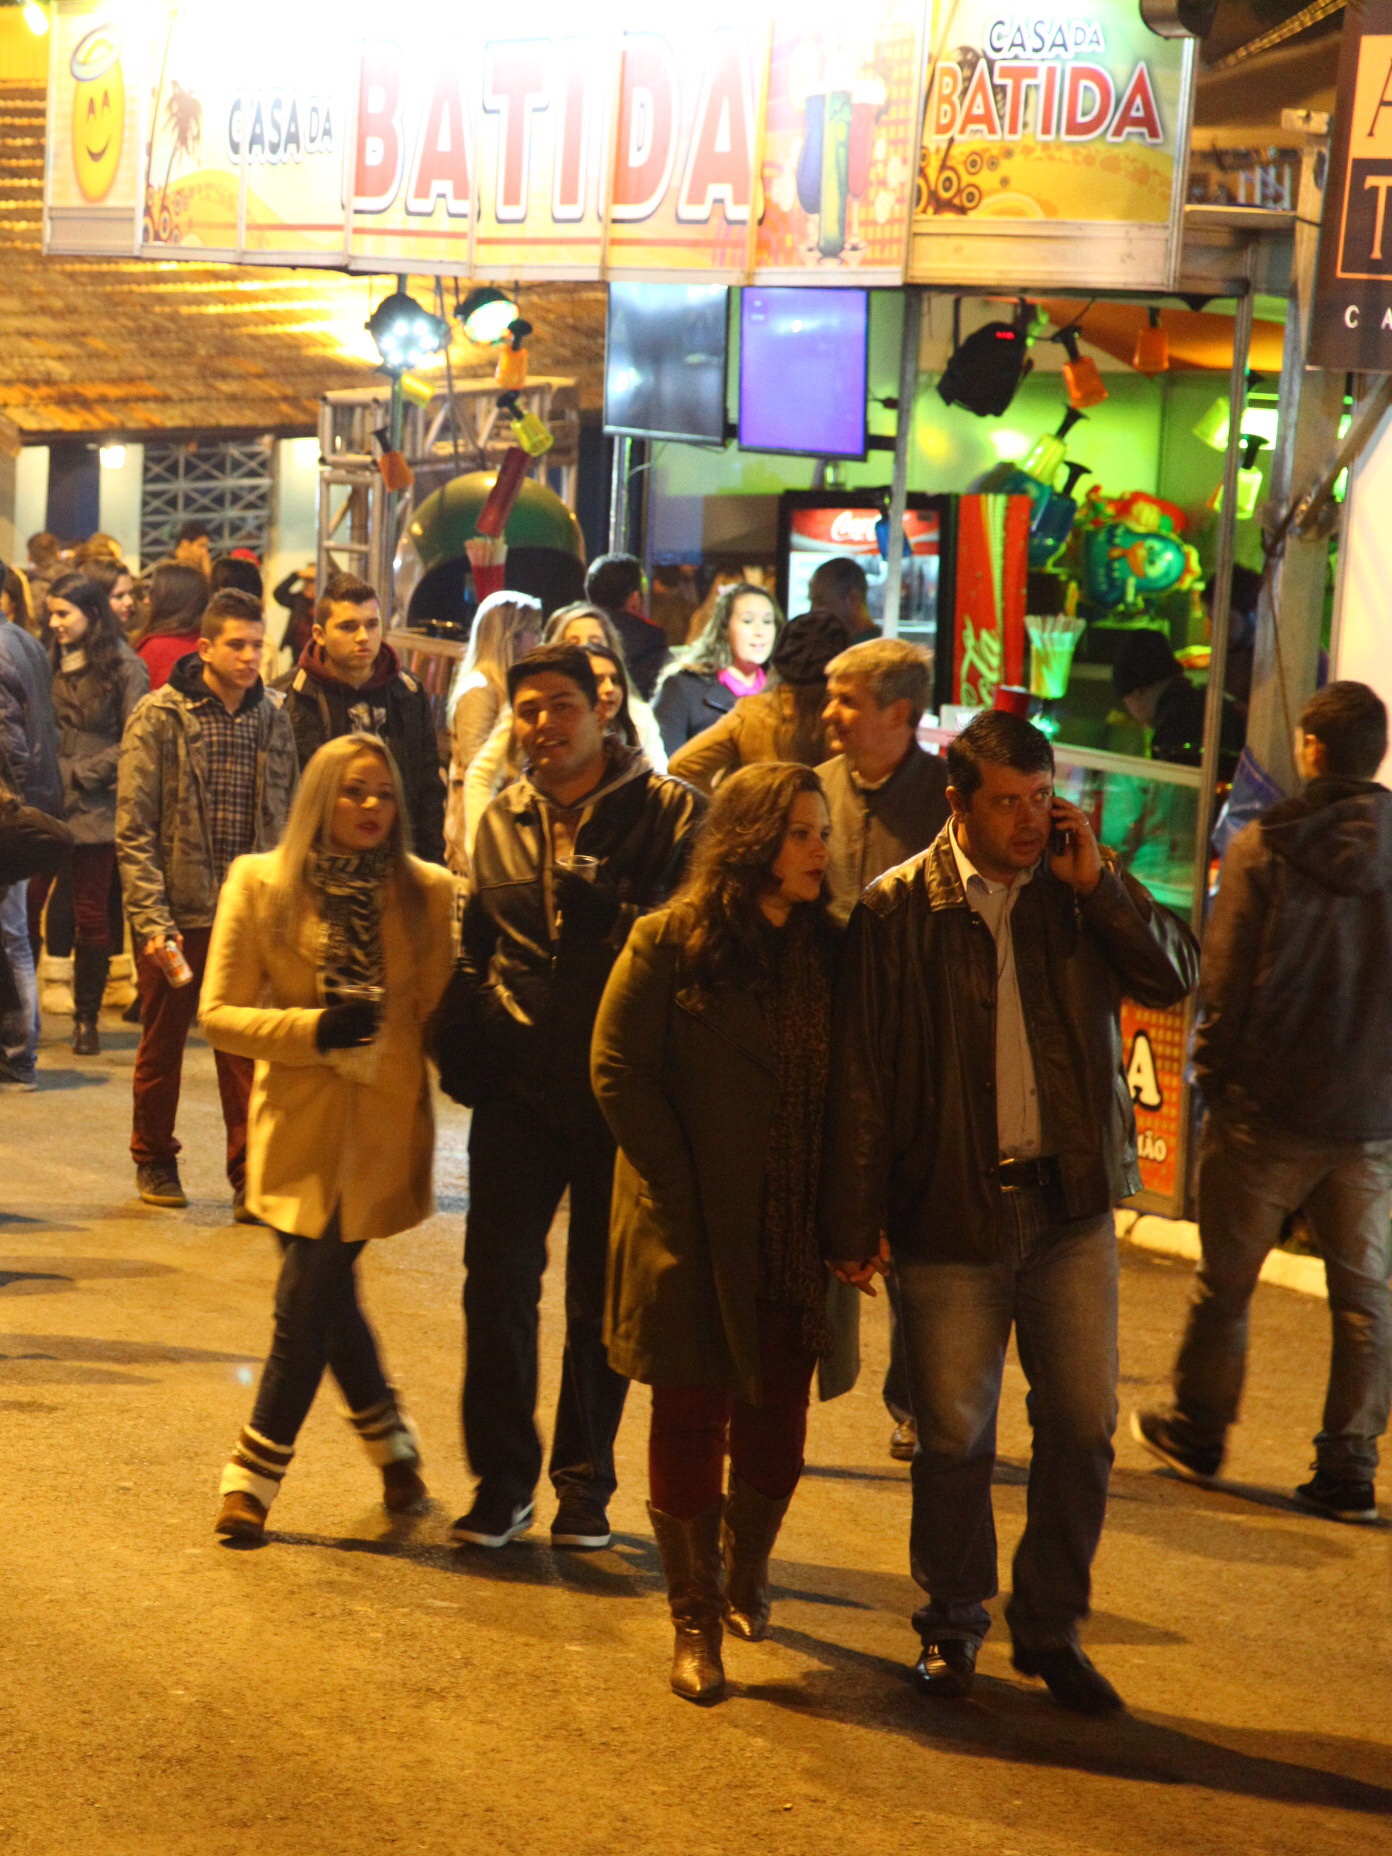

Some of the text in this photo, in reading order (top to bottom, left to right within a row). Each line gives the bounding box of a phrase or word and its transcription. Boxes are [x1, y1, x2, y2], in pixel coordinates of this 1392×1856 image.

[989, 20, 1101, 53] CASA DA
[227, 42, 760, 215] CASA DA BATIDA
[932, 61, 1164, 142] BATIDA
